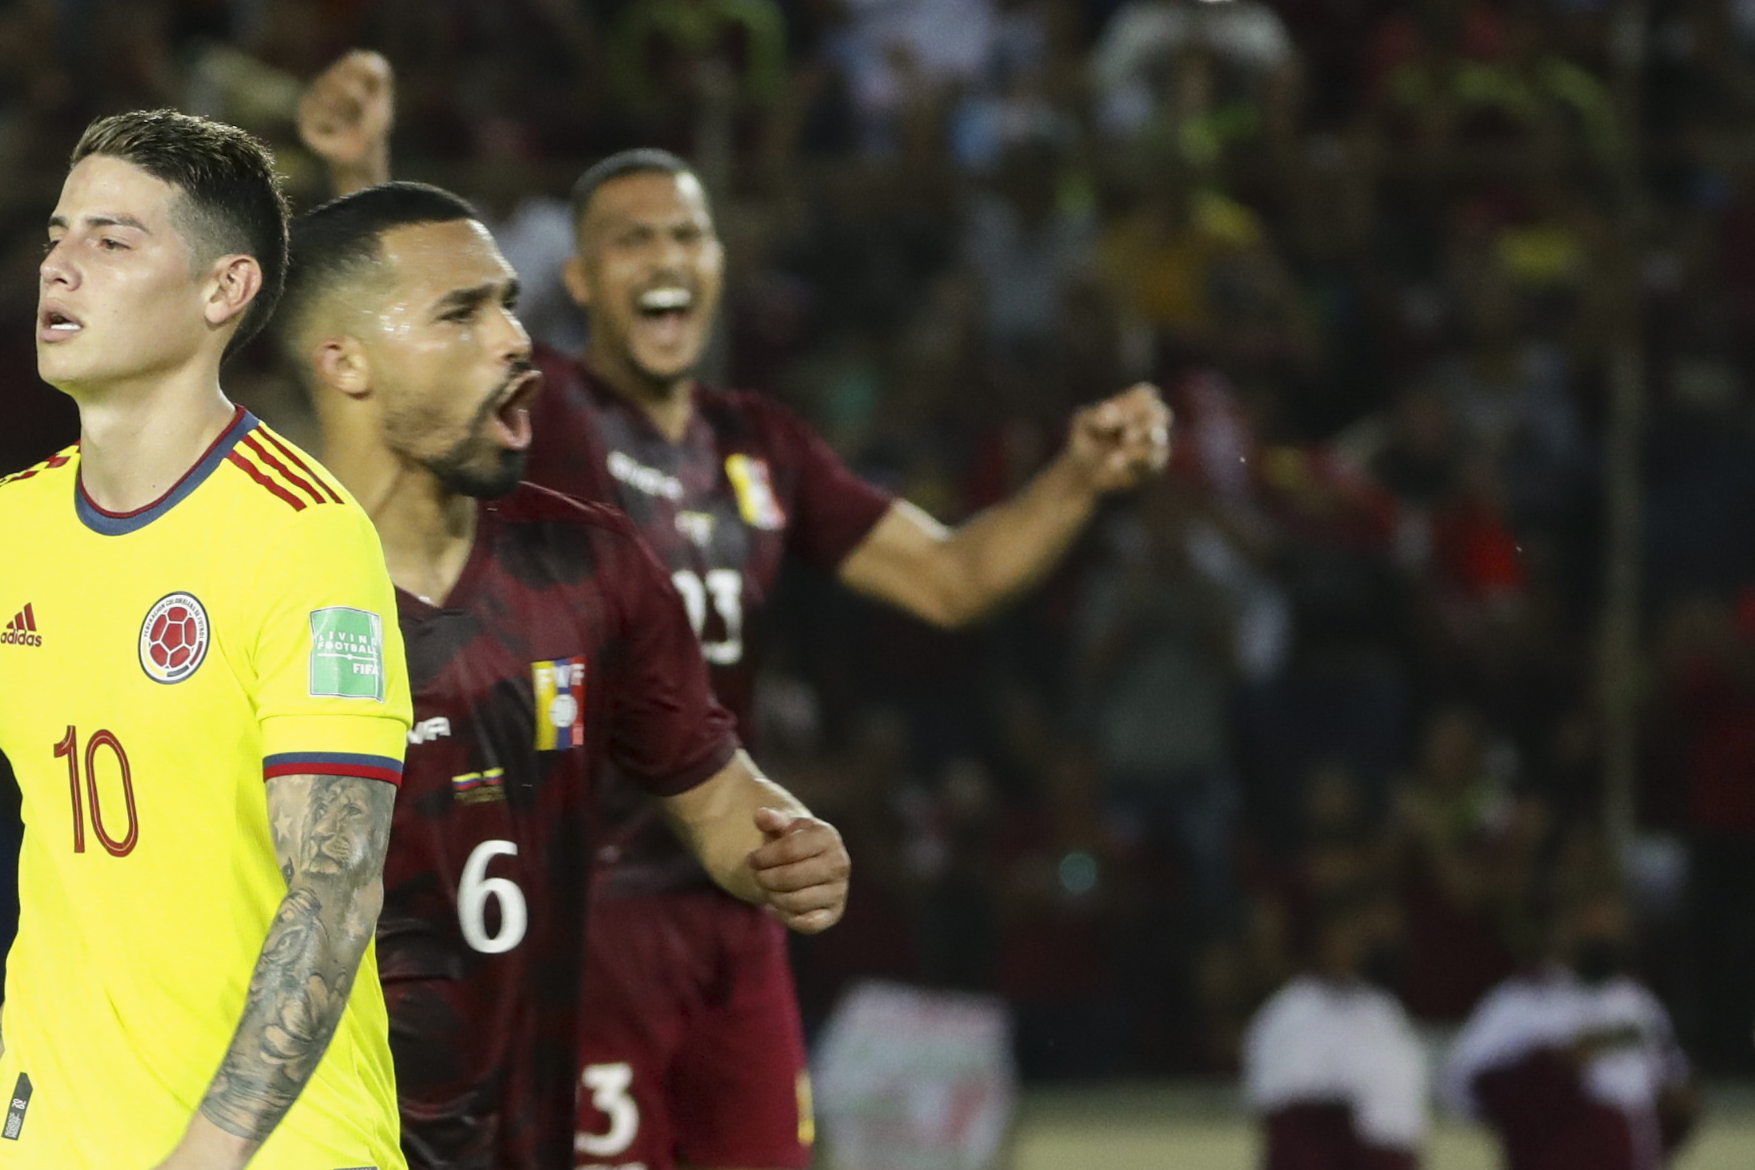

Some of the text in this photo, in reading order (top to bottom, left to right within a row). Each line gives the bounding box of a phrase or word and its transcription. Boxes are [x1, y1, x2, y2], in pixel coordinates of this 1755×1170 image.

[0, 629, 43, 647] adidas
[317, 641, 379, 656] FOOTBALL
[352, 663, 379, 675] FIFA
[53, 725, 140, 858] 10
[456, 840, 528, 954] 6
[573, 1061, 640, 1157] 3
